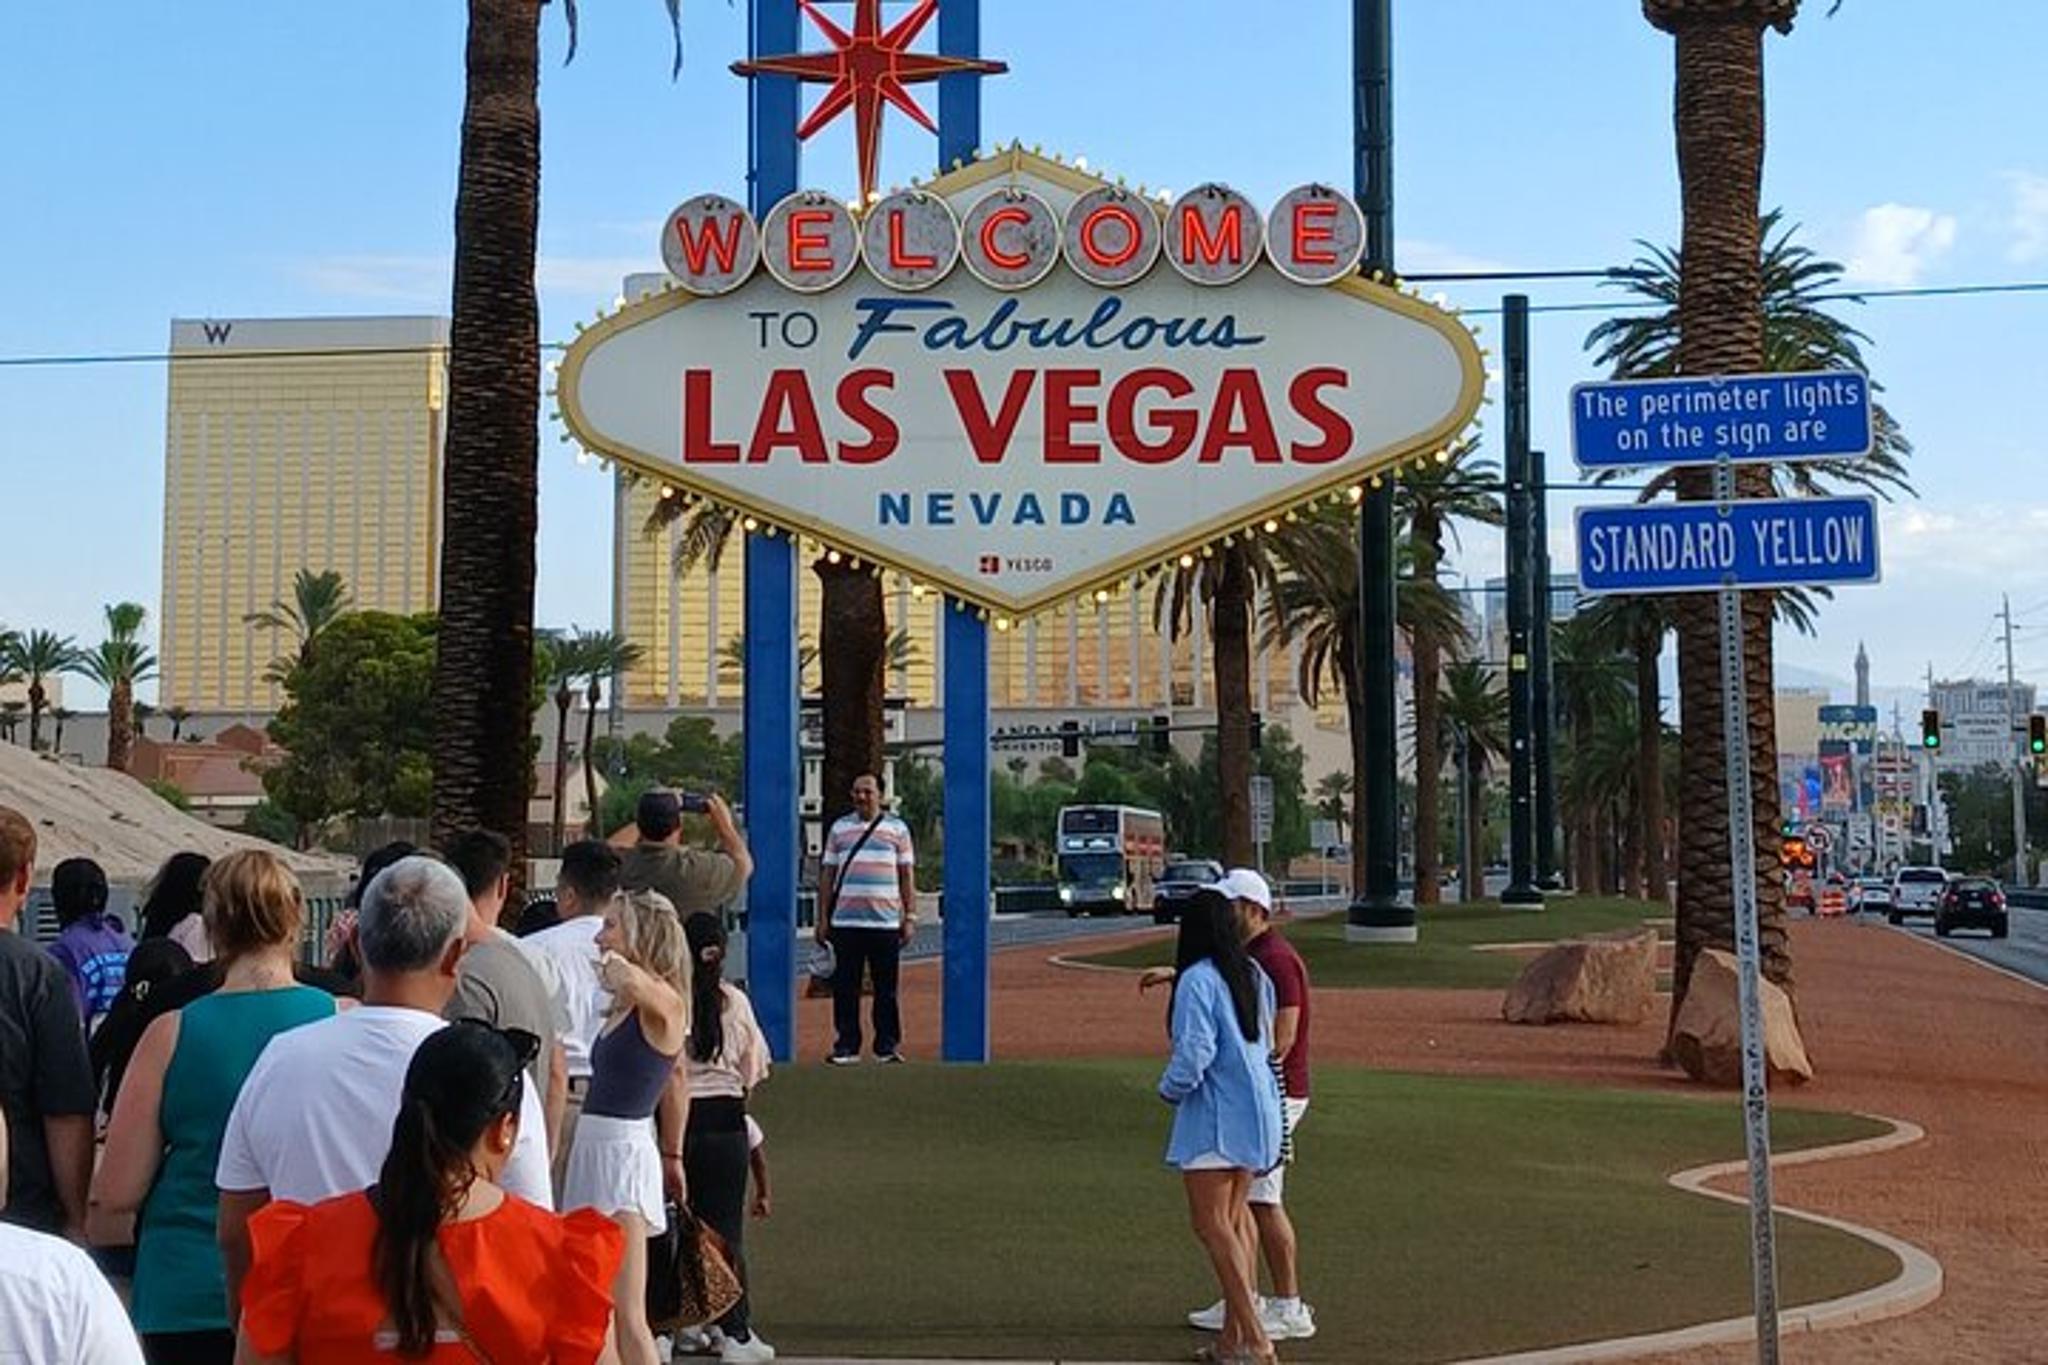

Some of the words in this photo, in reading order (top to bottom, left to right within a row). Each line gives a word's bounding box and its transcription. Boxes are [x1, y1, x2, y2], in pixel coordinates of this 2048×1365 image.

[676, 203, 1338, 276] WELCOME
[203, 323, 231, 344] W
[749, 311, 819, 349] TO
[847, 296, 1265, 361] Fabulous
[683, 368, 900, 464] LAS
[943, 367, 1355, 464] VEGAS
[1581, 390, 1627, 418] The
[1641, 387, 1772, 422] perimeter
[1784, 379, 1859, 416] lights
[1617, 430, 1648, 450] on
[1661, 422, 1705, 449] the
[1715, 421, 1771, 453] sign
[1784, 420, 1828, 442] are
[878, 493, 1136, 525] NEVADA
[1588, 521, 1737, 574] STANDARD
[1751, 515, 1865, 567] YELLOW
